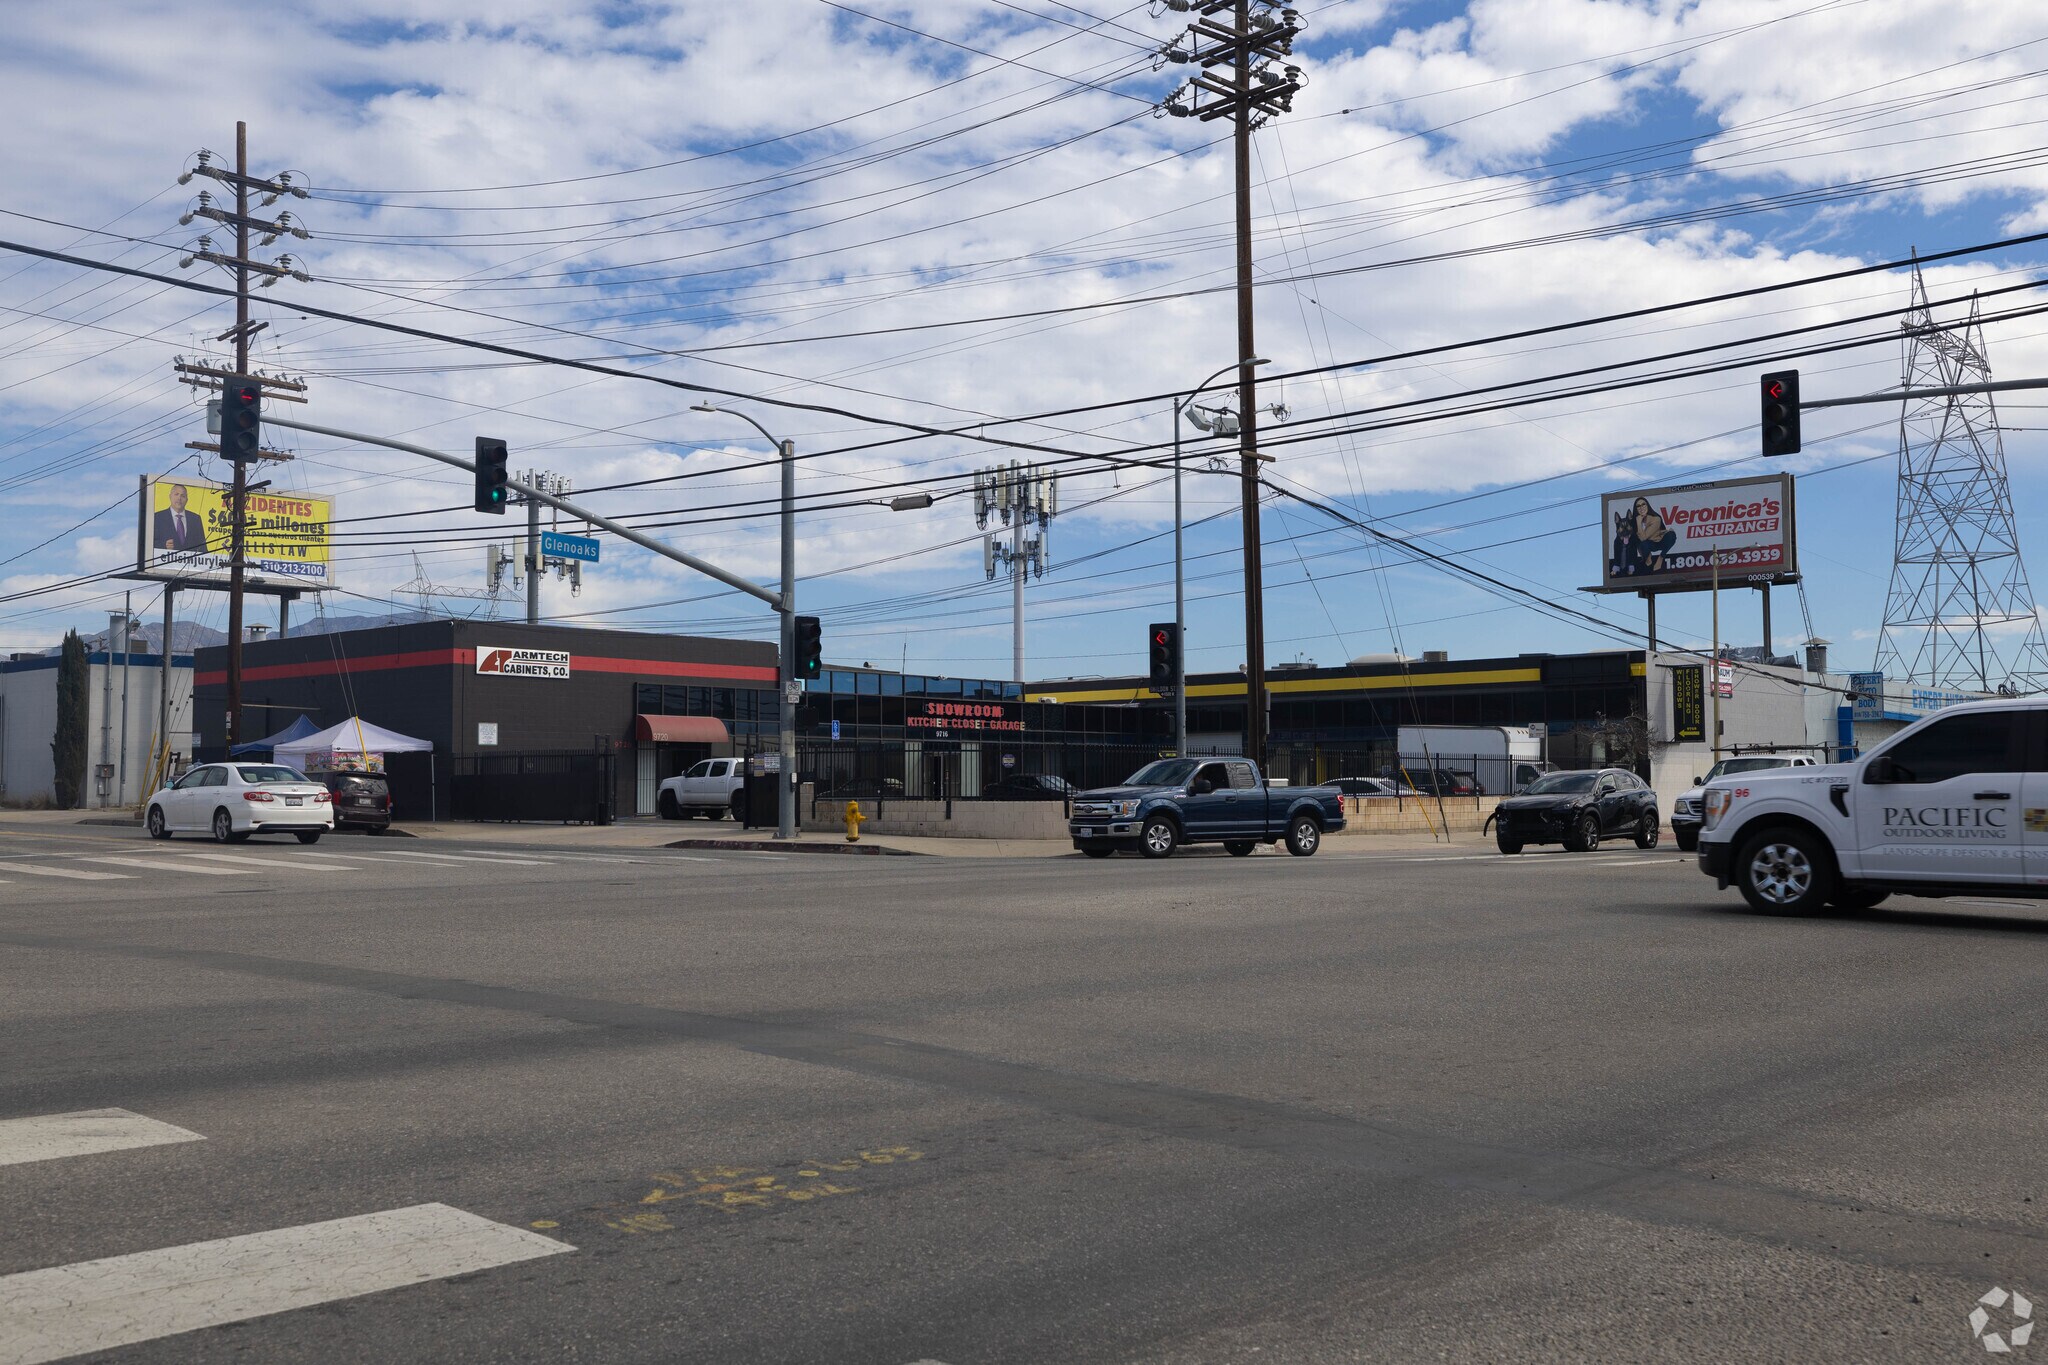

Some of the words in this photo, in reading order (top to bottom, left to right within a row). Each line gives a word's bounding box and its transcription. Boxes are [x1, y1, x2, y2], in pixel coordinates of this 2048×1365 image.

[222, 496, 312, 517] ACIDENTES
[1660, 498, 1780, 525] Veronica's
[261, 515, 325, 535] millones
[1690, 519, 1776, 538] INSURANCE
[299, 535, 325, 543] clientes
[245, 540, 275, 555] LLIS
[281, 544, 307, 558] LAW
[544, 537, 597, 557] Glenoaks
[262, 562, 324, 576] 310-213-2100
[1748, 573, 1775, 581] 000539
[513, 651, 568, 662] ARMTECH
[504, 664, 551, 677] CABINETS,
[553, 667, 568, 676] CO.
[1858, 699, 1877, 707] BODY
[1912, 689, 1942, 710] EXPERT
[928, 703, 1002, 717] SHOWROOM
[907, 717, 949, 728] KITCHEN
[952, 719, 986, 729] CLOSET
[990, 721, 1026, 731] GARAGE
[653, 733, 669, 741] 9720
[1734, 789, 1750, 797] 96
[1882, 807, 2007, 827] PACIFIC
[1883, 829, 1955, 837] OUTDOOR
[1958, 829, 2007, 839] LIVING
[1882, 848, 1948, 857] LANDSCAPE
[1952, 849, 1998, 858] DESIGN
